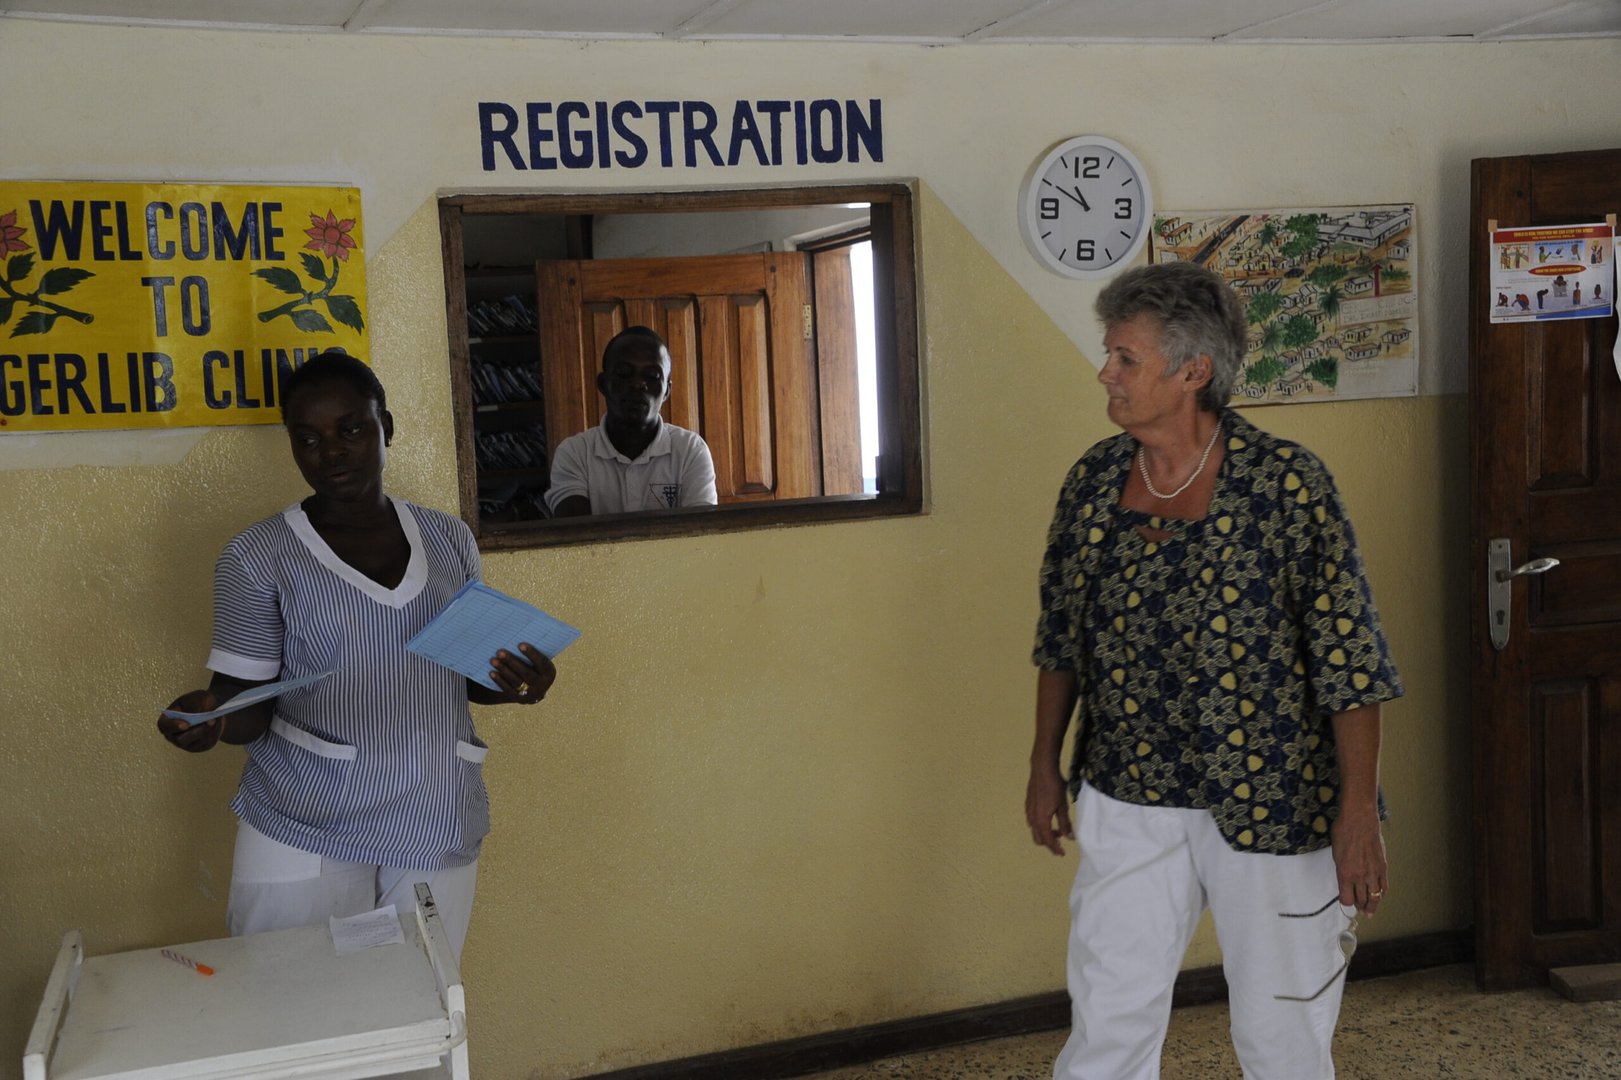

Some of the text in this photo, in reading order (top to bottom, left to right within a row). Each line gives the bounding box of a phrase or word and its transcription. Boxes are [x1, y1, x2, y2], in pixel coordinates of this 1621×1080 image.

[478, 99, 883, 171] REGISTRATION
[1074, 156, 1100, 179] 12
[29, 199, 286, 261] WELCOME
[1040, 198, 1059, 220] 9
[1114, 198, 1132, 220] 3
[1076, 239, 1095, 261] 6
[140, 275, 212, 337] TO
[0, 346, 347, 416] GERLIB CLIN
